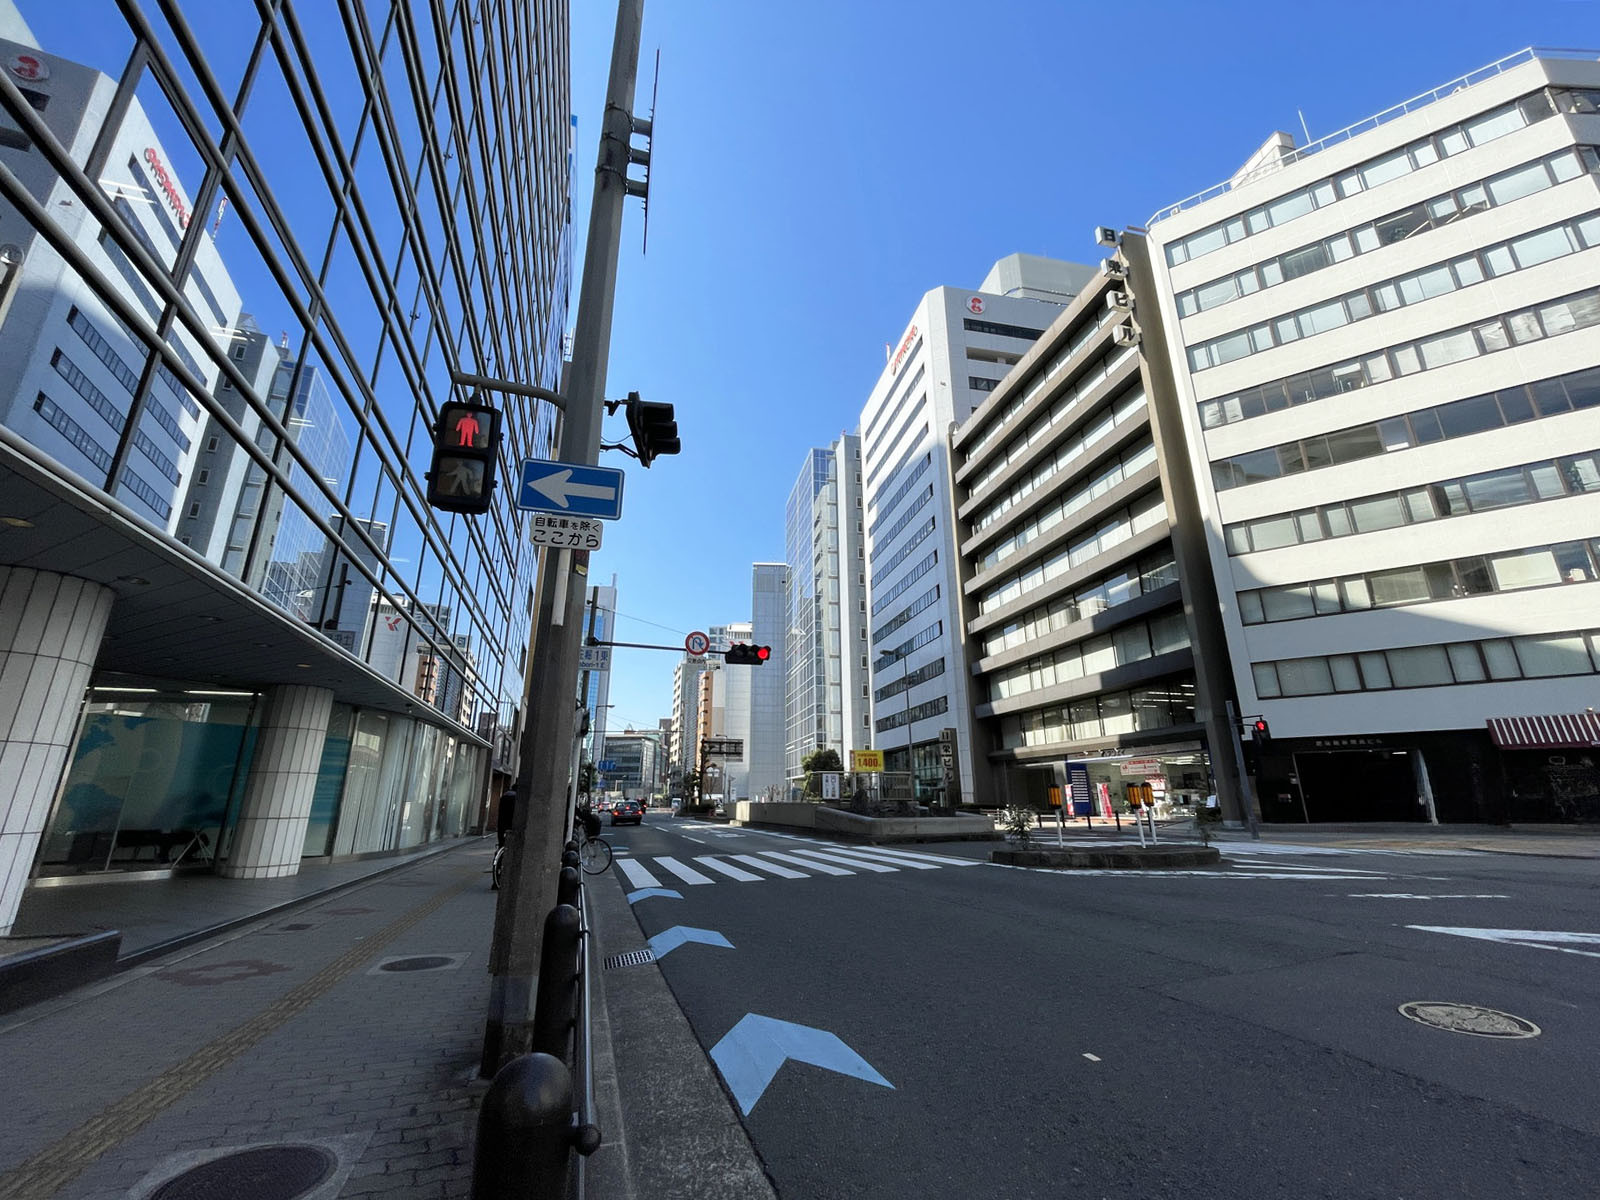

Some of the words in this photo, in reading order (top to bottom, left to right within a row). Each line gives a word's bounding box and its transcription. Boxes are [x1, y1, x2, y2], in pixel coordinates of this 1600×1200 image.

[1103, 228, 1136, 342] 日栄ビル
[535, 516, 600, 532] 自転車を除く
[533, 529, 599, 548] ここから
